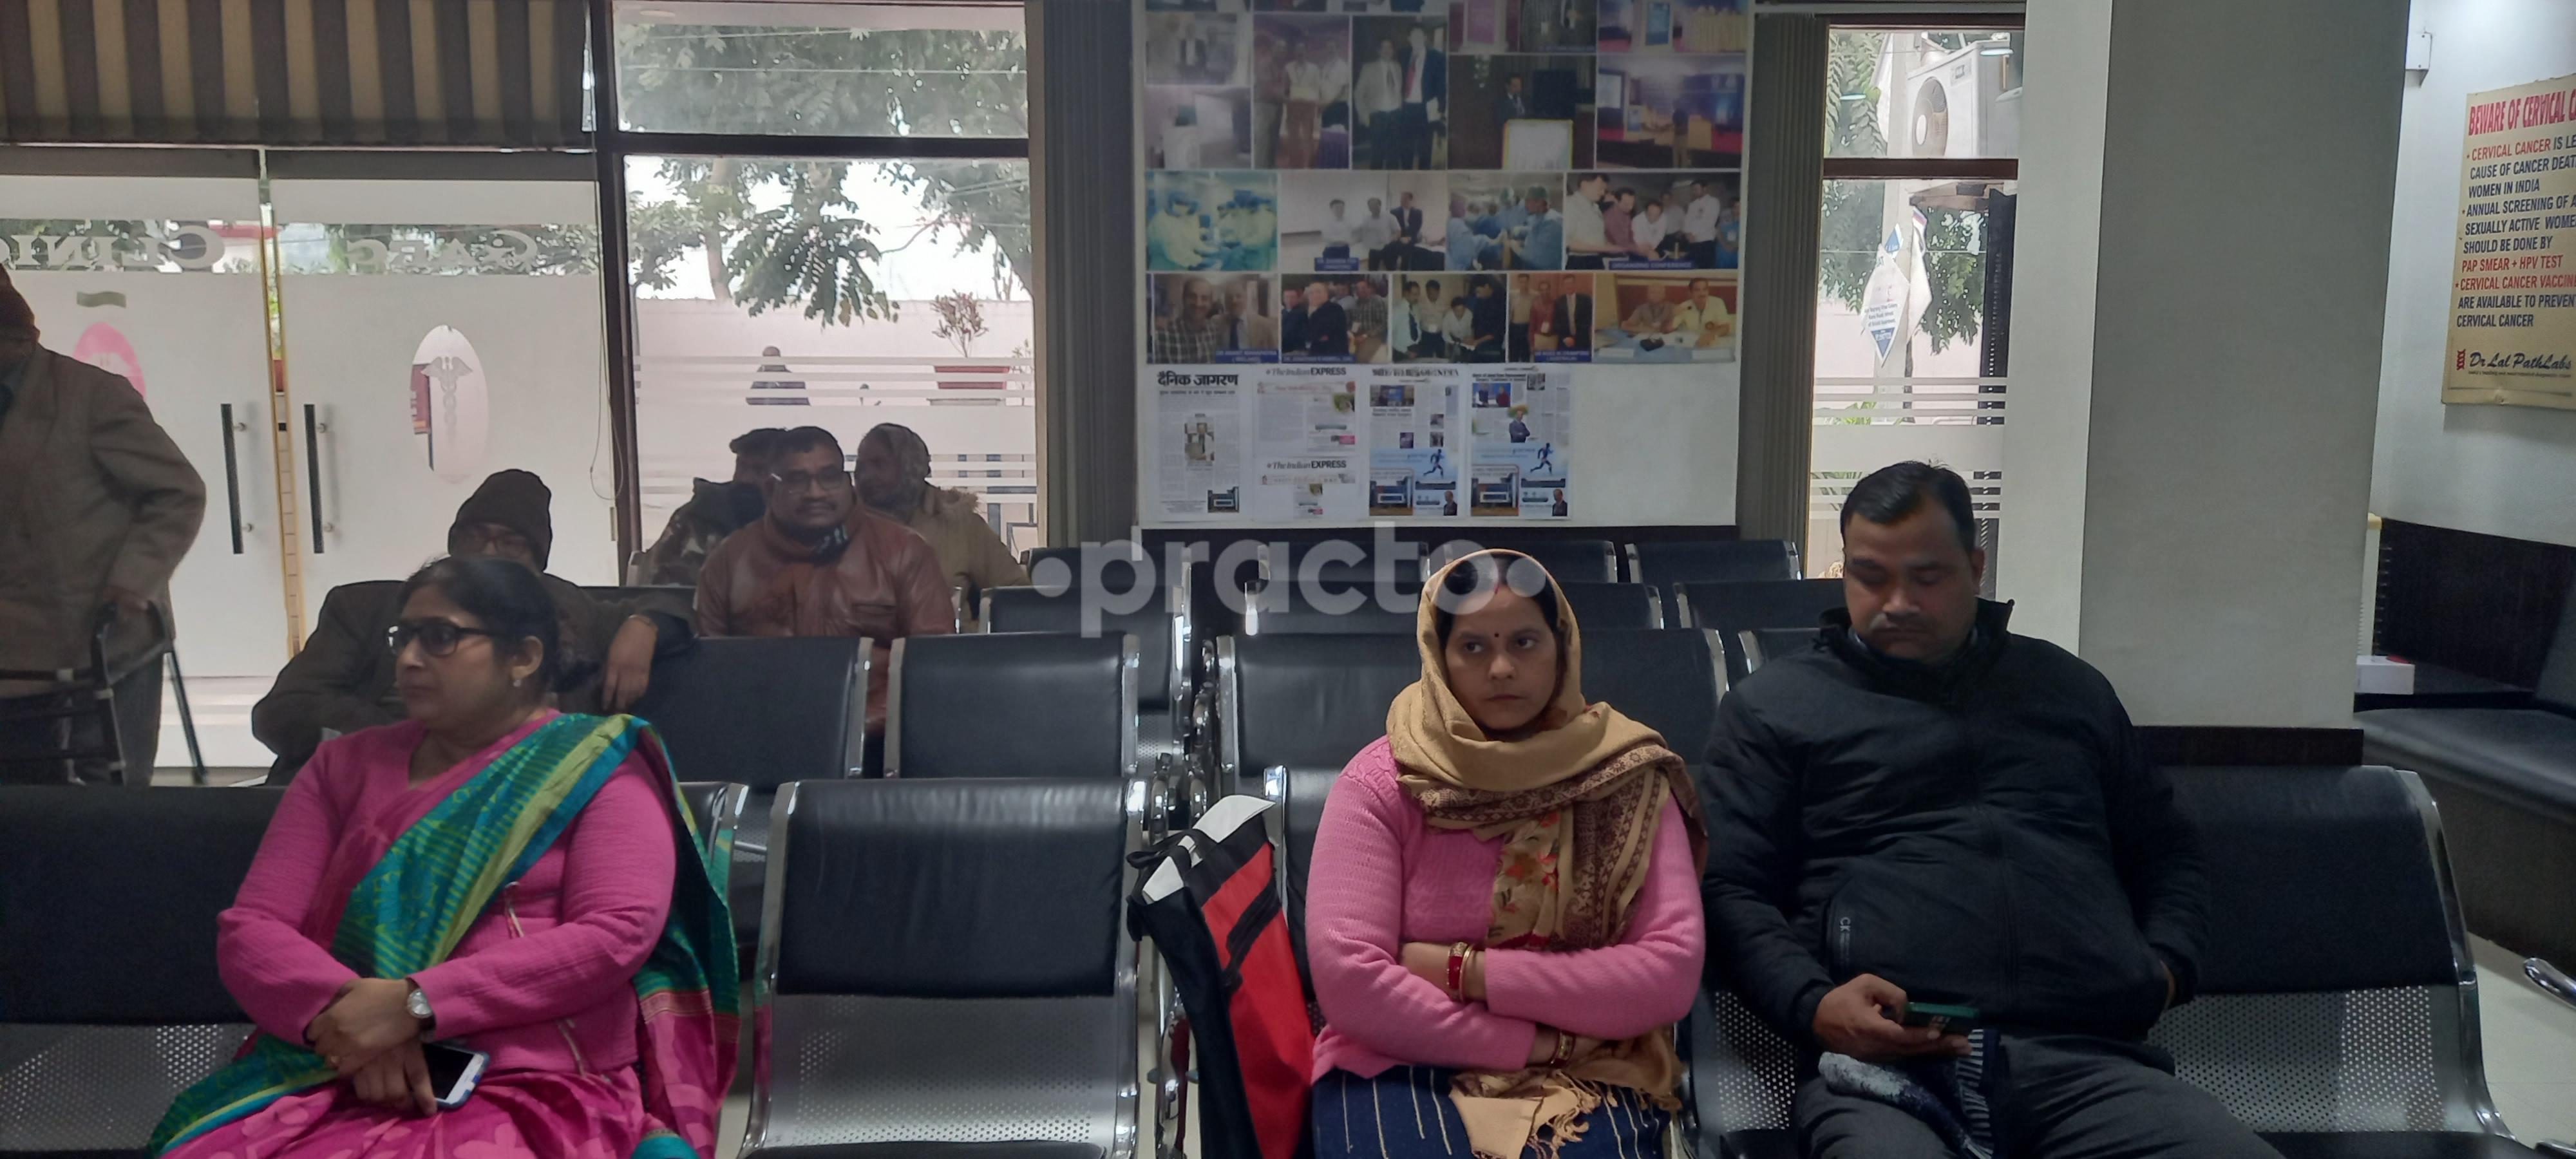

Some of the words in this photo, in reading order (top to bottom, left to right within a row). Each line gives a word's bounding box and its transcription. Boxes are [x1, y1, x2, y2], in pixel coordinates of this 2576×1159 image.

[2468, 101, 2506, 136] BEWARE
[2508, 99, 2521, 129] OF
[2523, 91, 2566, 127] CERVICAL
[2472, 144, 2512, 160] CERVICAL
[2515, 138, 2551, 155] CANCER
[2553, 137, 2563, 150] IS
[2470, 164, 2497, 180] CAUSE
[2499, 163, 2511, 176] OF
[2513, 158, 2549, 174] CANCER
[2552, 155, 2576, 171] DEAT
[2468, 183, 2501, 198] WOMEN
[2503, 181, 2513, 194] IN
[2515, 178, 2540, 193] INDIA
[2467, 202, 2500, 217] ANNUAL
[2503, 197, 2553, 214] SCREENING
[2556, 195, 2569, 209] OF
[2465, 220, 2507, 235] SEXUALLY
[2509, 217, 2541, 232] ACTIVE
[2463, 240, 2498, 254] SHOULD
[2500, 238, 2511, 251] BE
[2513, 237, 2538, 251] DONE
[2540, 236, 2553, 249] BY
[2462, 259, 2477, 273] PAP
[2479, 258, 2510, 271] SMEAR
[2519, 256, 2539, 269] HPV
[2541, 255, 2564, 268] TEST
[2460, 277, 2500, 290] CERVICAL
[2503, 276, 2537, 289] CANCER
[2458, 296, 2475, 309] ARE
[2476, 295, 2522, 309] AVAILABLE
[2524, 295, 2536, 307] TO
[2457, 315, 2496, 327] CERVICAL
[2499, 314, 2534, 327] CANCER
[2470, 352, 2486, 367] Dr
[2487, 352, 2511, 368] Lal
[2513, 352, 2571, 370] PathLabs
[1157, 370, 1191, 386] दैनिक
[1193, 374, 1238, 386] जागरण
[1311, 367, 1347, 375] EXPRESS
[1311, 460, 1347, 469] EXPRESS
